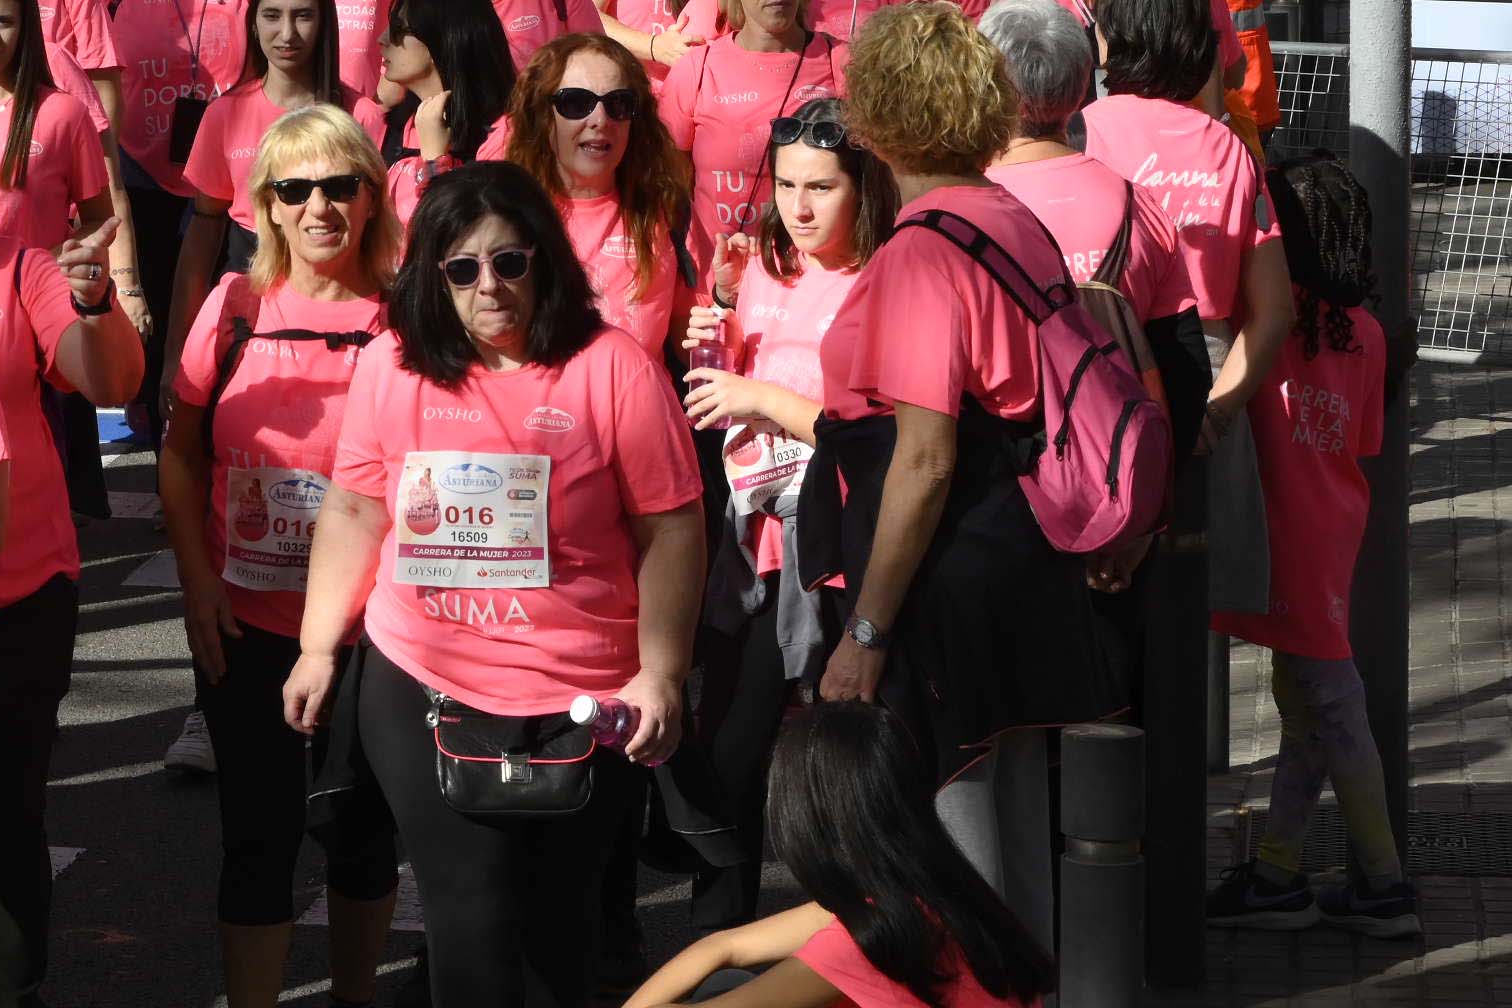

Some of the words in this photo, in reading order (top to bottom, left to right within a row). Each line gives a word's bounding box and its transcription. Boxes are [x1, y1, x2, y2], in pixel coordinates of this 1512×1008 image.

[138, 57, 168, 79] TU
[713, 91, 760, 105] OYSHO
[712, 170, 745, 193] TU
[422, 407, 483, 423] OYSHO
[443, 474, 498, 488] ASTURIANA
[745, 470, 778, 486] CARRERA
[777, 467, 787, 477] DE
[444, 505, 495, 526] 016
[450, 530, 489, 544] 16509
[239, 549, 276, 564] CARRERA
[413, 547, 453, 557] CARRERA
[454, 548, 465, 557] DE
[467, 549, 478, 558] LA
[479, 549, 509, 558] MUJER
[512, 549, 532, 558] 2023
[234, 566, 277, 584] OYSHO
[408, 566, 452, 578] OYSHO
[489, 567, 536, 579] Santander
[424, 587, 531, 626] SUMA
